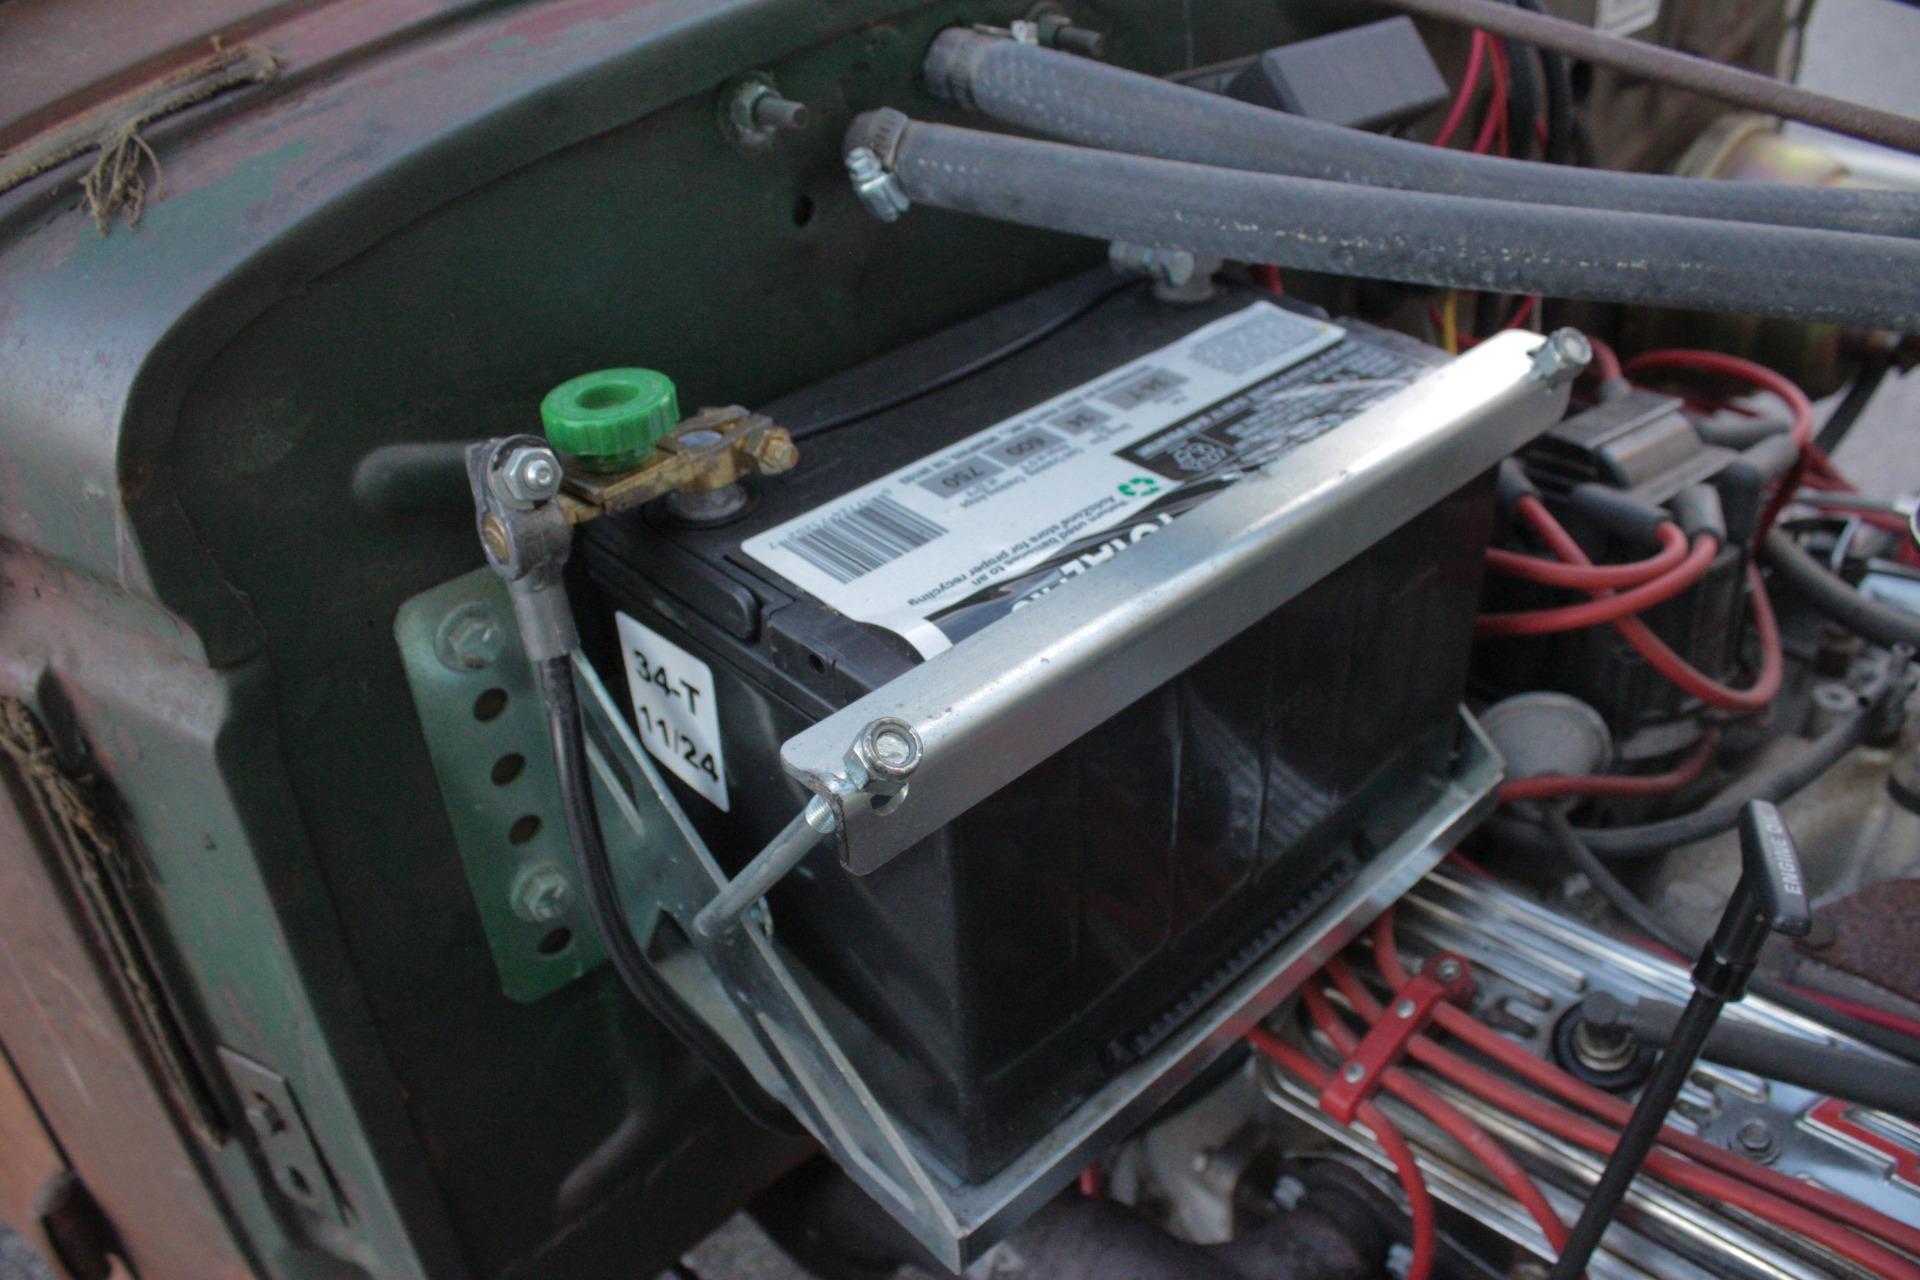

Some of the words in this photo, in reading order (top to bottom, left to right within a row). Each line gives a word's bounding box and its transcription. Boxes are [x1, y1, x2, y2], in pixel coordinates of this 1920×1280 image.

[941, 466, 984, 489] 750
[1030, 522, 1060, 543] store
[1060, 520, 1088, 541] used
[1011, 538, 1030, 555] for
[968, 550, 1009, 580] proper
[991, 564, 1005, 577] to
[907, 571, 967, 606] recycling
[971, 574, 989, 587] an
[633, 651, 700, 715] 34-T
[639, 705, 719, 783] 11/24
[1770, 835, 1802, 896] ENGINE
